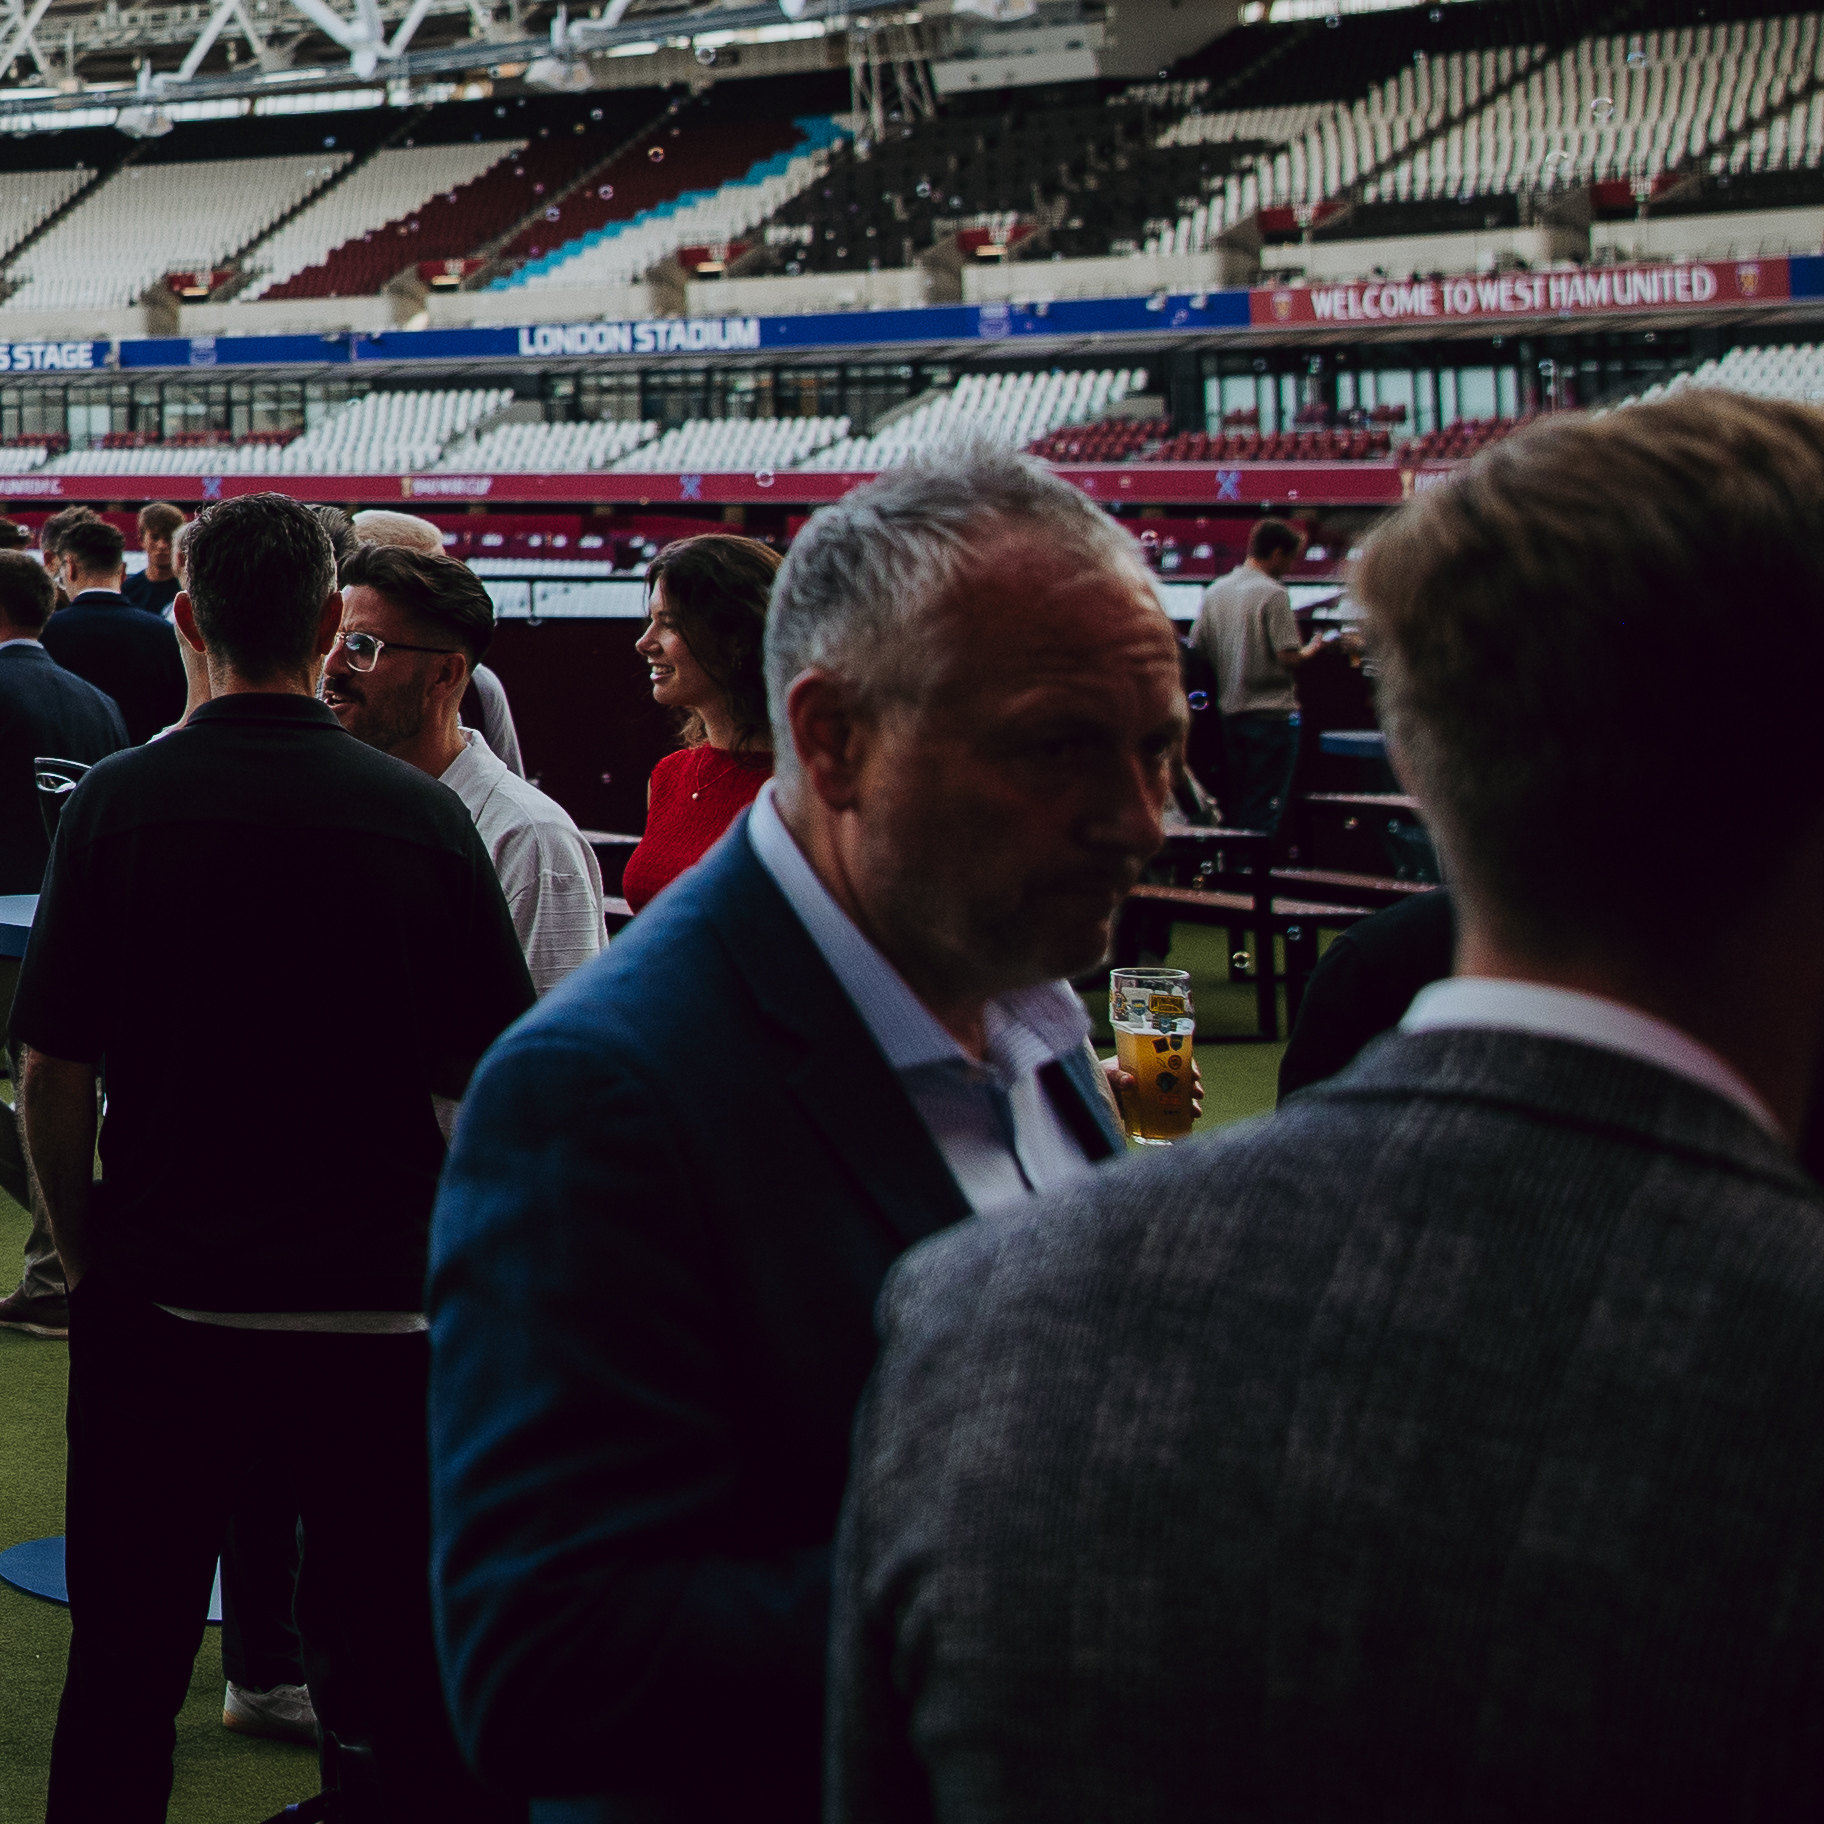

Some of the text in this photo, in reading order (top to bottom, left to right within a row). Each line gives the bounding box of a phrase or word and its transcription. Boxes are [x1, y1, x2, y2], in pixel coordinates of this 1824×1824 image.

[1310, 266, 1718, 321] WELCOME TO WEST HAM UNITED
[518, 317, 761, 356] LONDON STADIUM
[11, 342, 94, 371] STAGE
